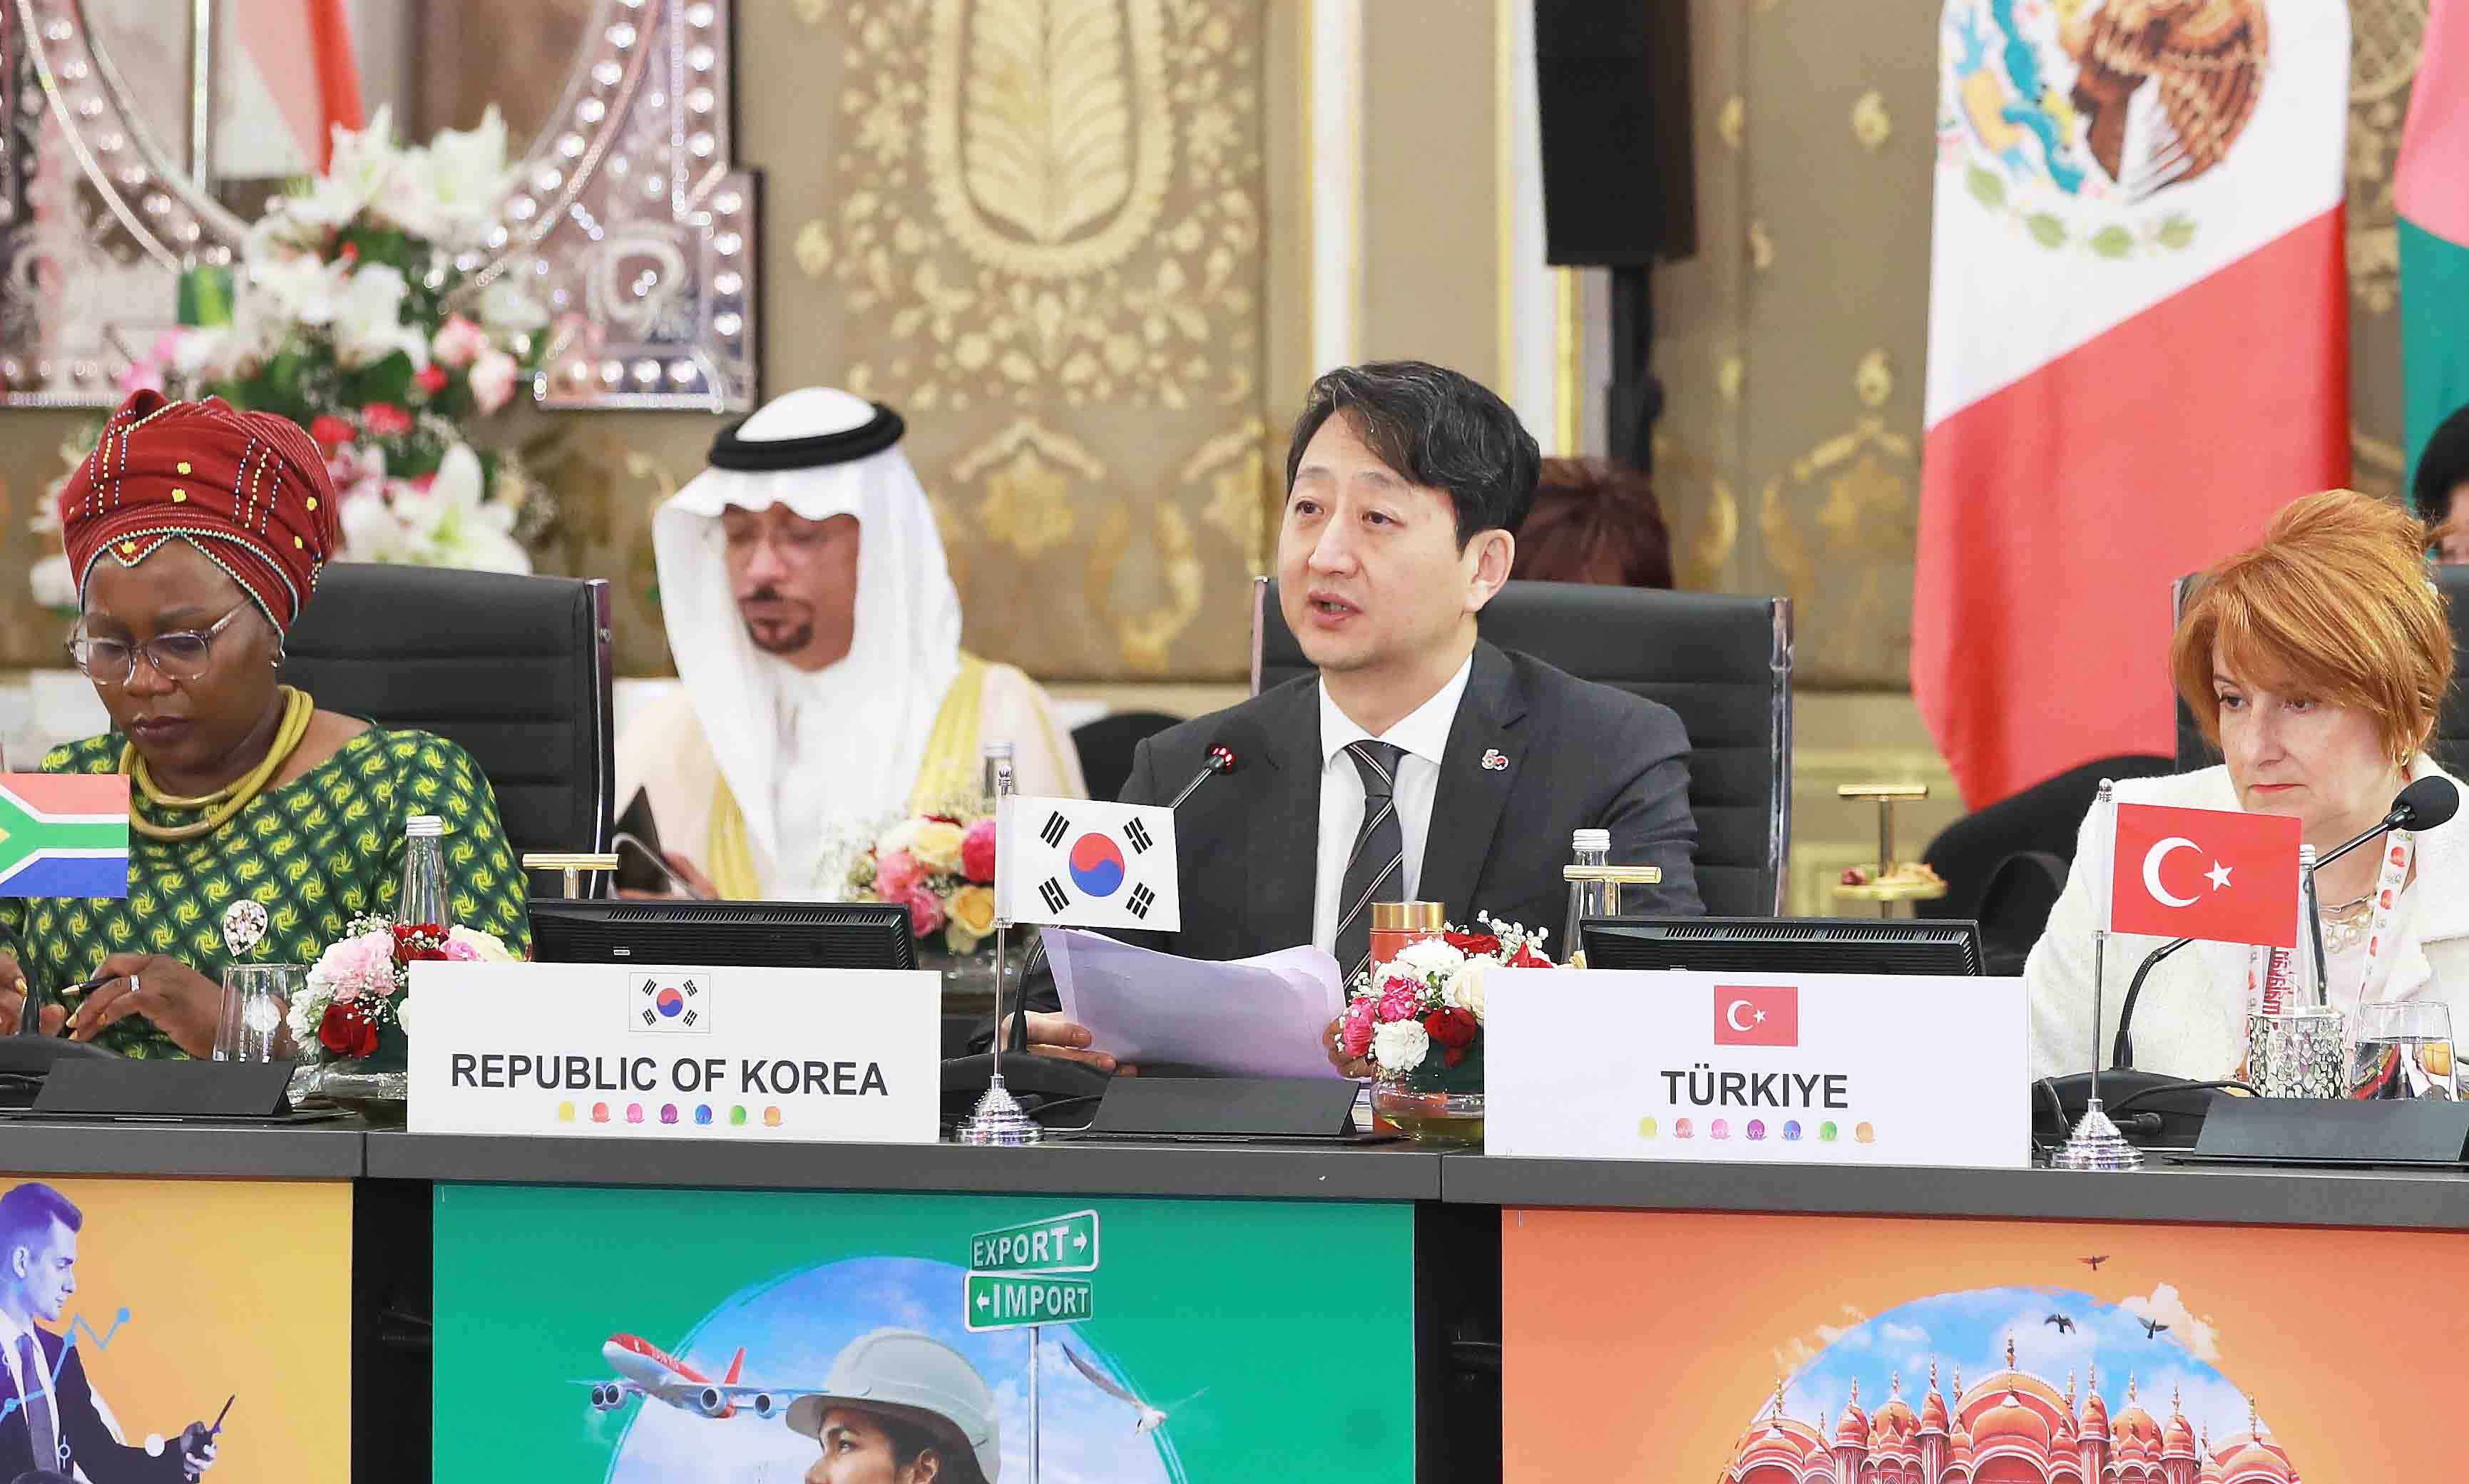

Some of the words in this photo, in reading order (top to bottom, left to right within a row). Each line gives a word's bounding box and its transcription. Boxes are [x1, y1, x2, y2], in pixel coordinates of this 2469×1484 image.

[451, 1053, 657, 1091] REPUBLIC
[672, 1058, 726, 1092] OF
[742, 1059, 889, 1096] KOREA
[1660, 1063, 1848, 1109] TÜRKIYE
[973, 1227, 1070, 1267] EXPORT
[993, 1284, 1089, 1319] IMPORT
